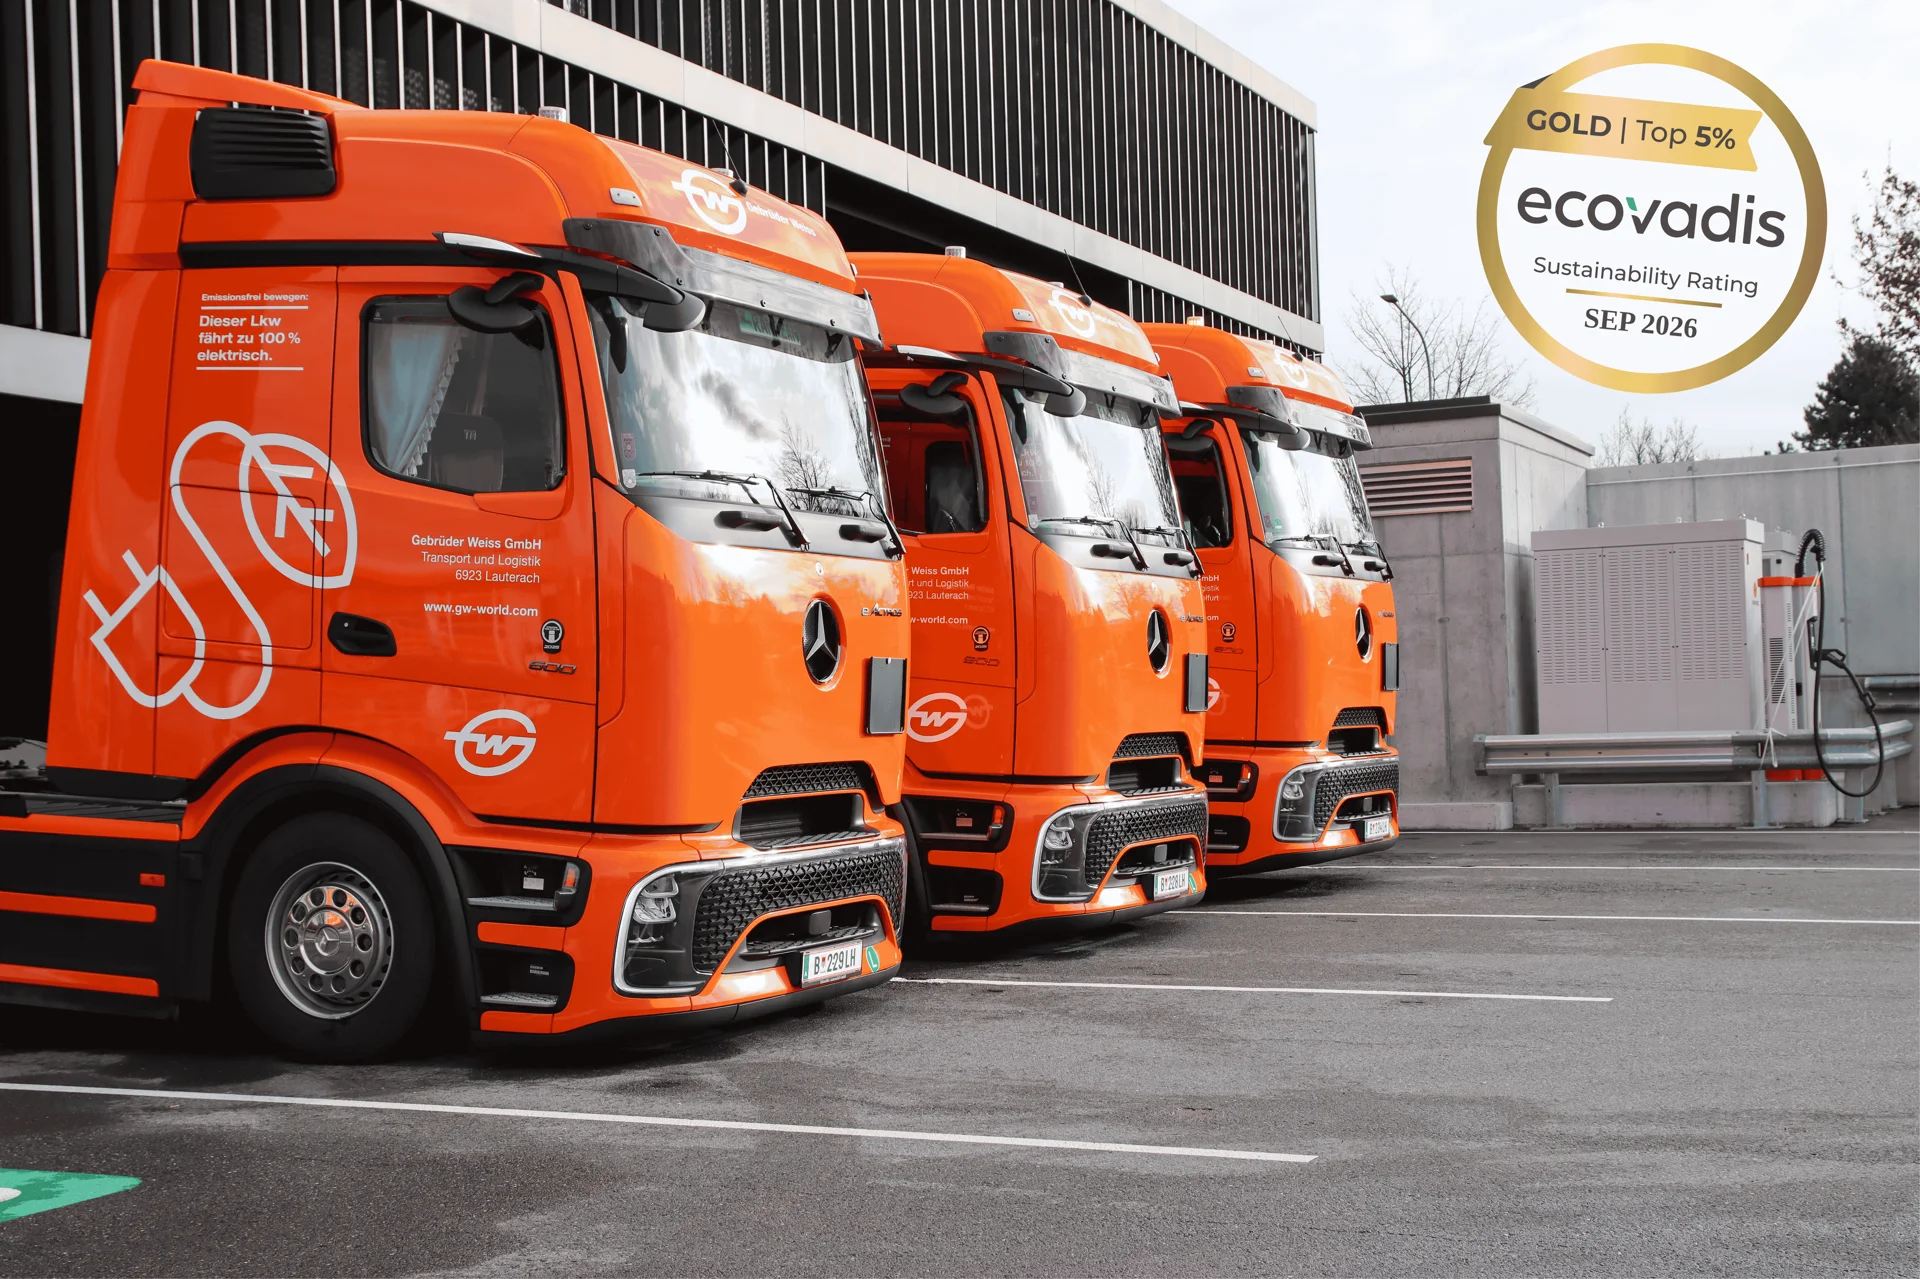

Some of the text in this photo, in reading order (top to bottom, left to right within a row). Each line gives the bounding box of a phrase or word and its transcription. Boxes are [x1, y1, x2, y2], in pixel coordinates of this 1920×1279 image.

[788, 217, 816, 237] Weiss
[201, 293, 309, 303] Emissionsfrei bewegen:
[199, 315, 281, 327] Dieser Lkw
[199, 332, 301, 344] fährt zu 100 %
[197, 349, 273, 361] elektrisch.
[411, 534, 542, 550] Gebrüder Weiss GmbH
[421, 551, 541, 569] Transport und Logistik
[455, 569, 541, 584] 6923 Lauterach
[911, 566, 969, 575] Weiss GmbH
[1201, 574, 1220, 582] mbH
[916, 579, 933, 587] und
[936, 579, 969, 590] Logistik
[909, 590, 969, 600] 923 Lauterach
[424, 602, 539, 617] www.gw-world.com
[910, 615, 969, 624] w-world.com
[528, 659, 577, 675] 600
[813, 955, 820, 975] B
